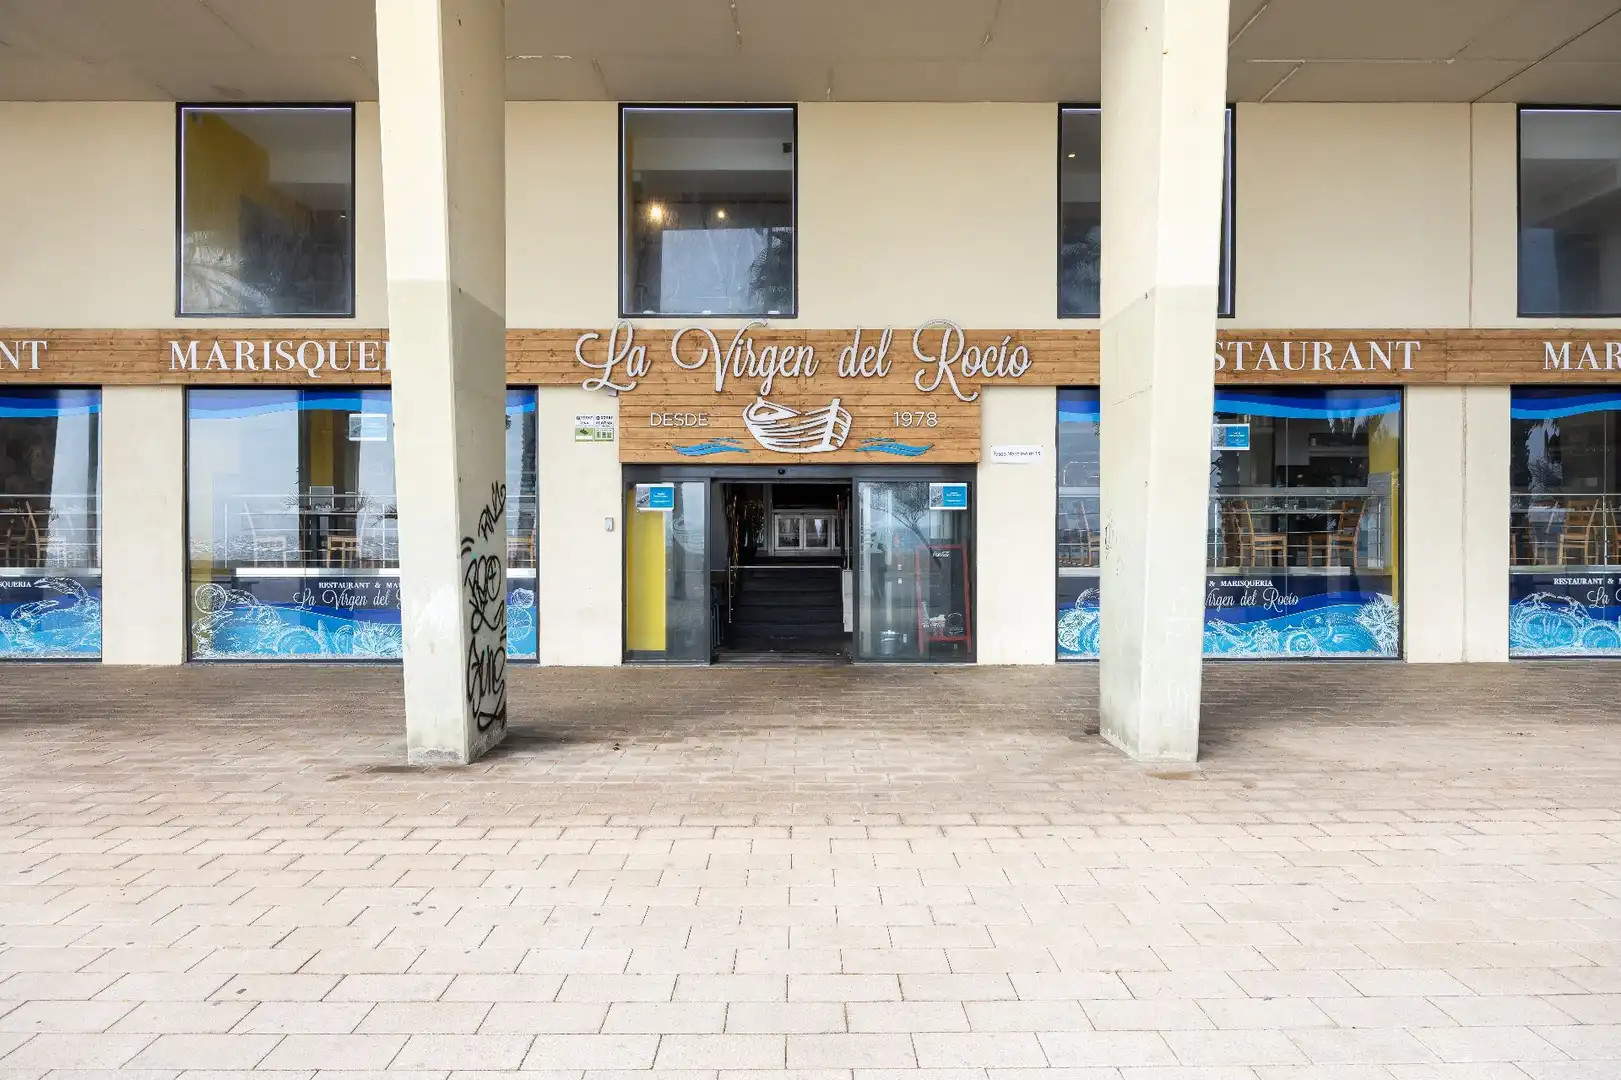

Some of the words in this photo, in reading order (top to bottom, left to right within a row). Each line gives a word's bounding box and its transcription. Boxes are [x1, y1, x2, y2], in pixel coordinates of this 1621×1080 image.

[575, 318, 652, 392] La
[671, 318, 820, 396] Virgen
[838, 324, 893, 378] del
[912, 318, 1032, 402] Rocío
[650, 412, 709, 427] DESDE
[893, 411, 938, 428] 1978
[1221, 580, 1273, 589] MARISQUERIA
[1553, 577, 1603, 585] RESTAURANT
[293, 588, 317, 610] La
[322, 587, 368, 611] Virgen
[373, 589, 391, 606] del
[1240, 589, 1257, 606] del
[1587, 586, 1611, 609] La
